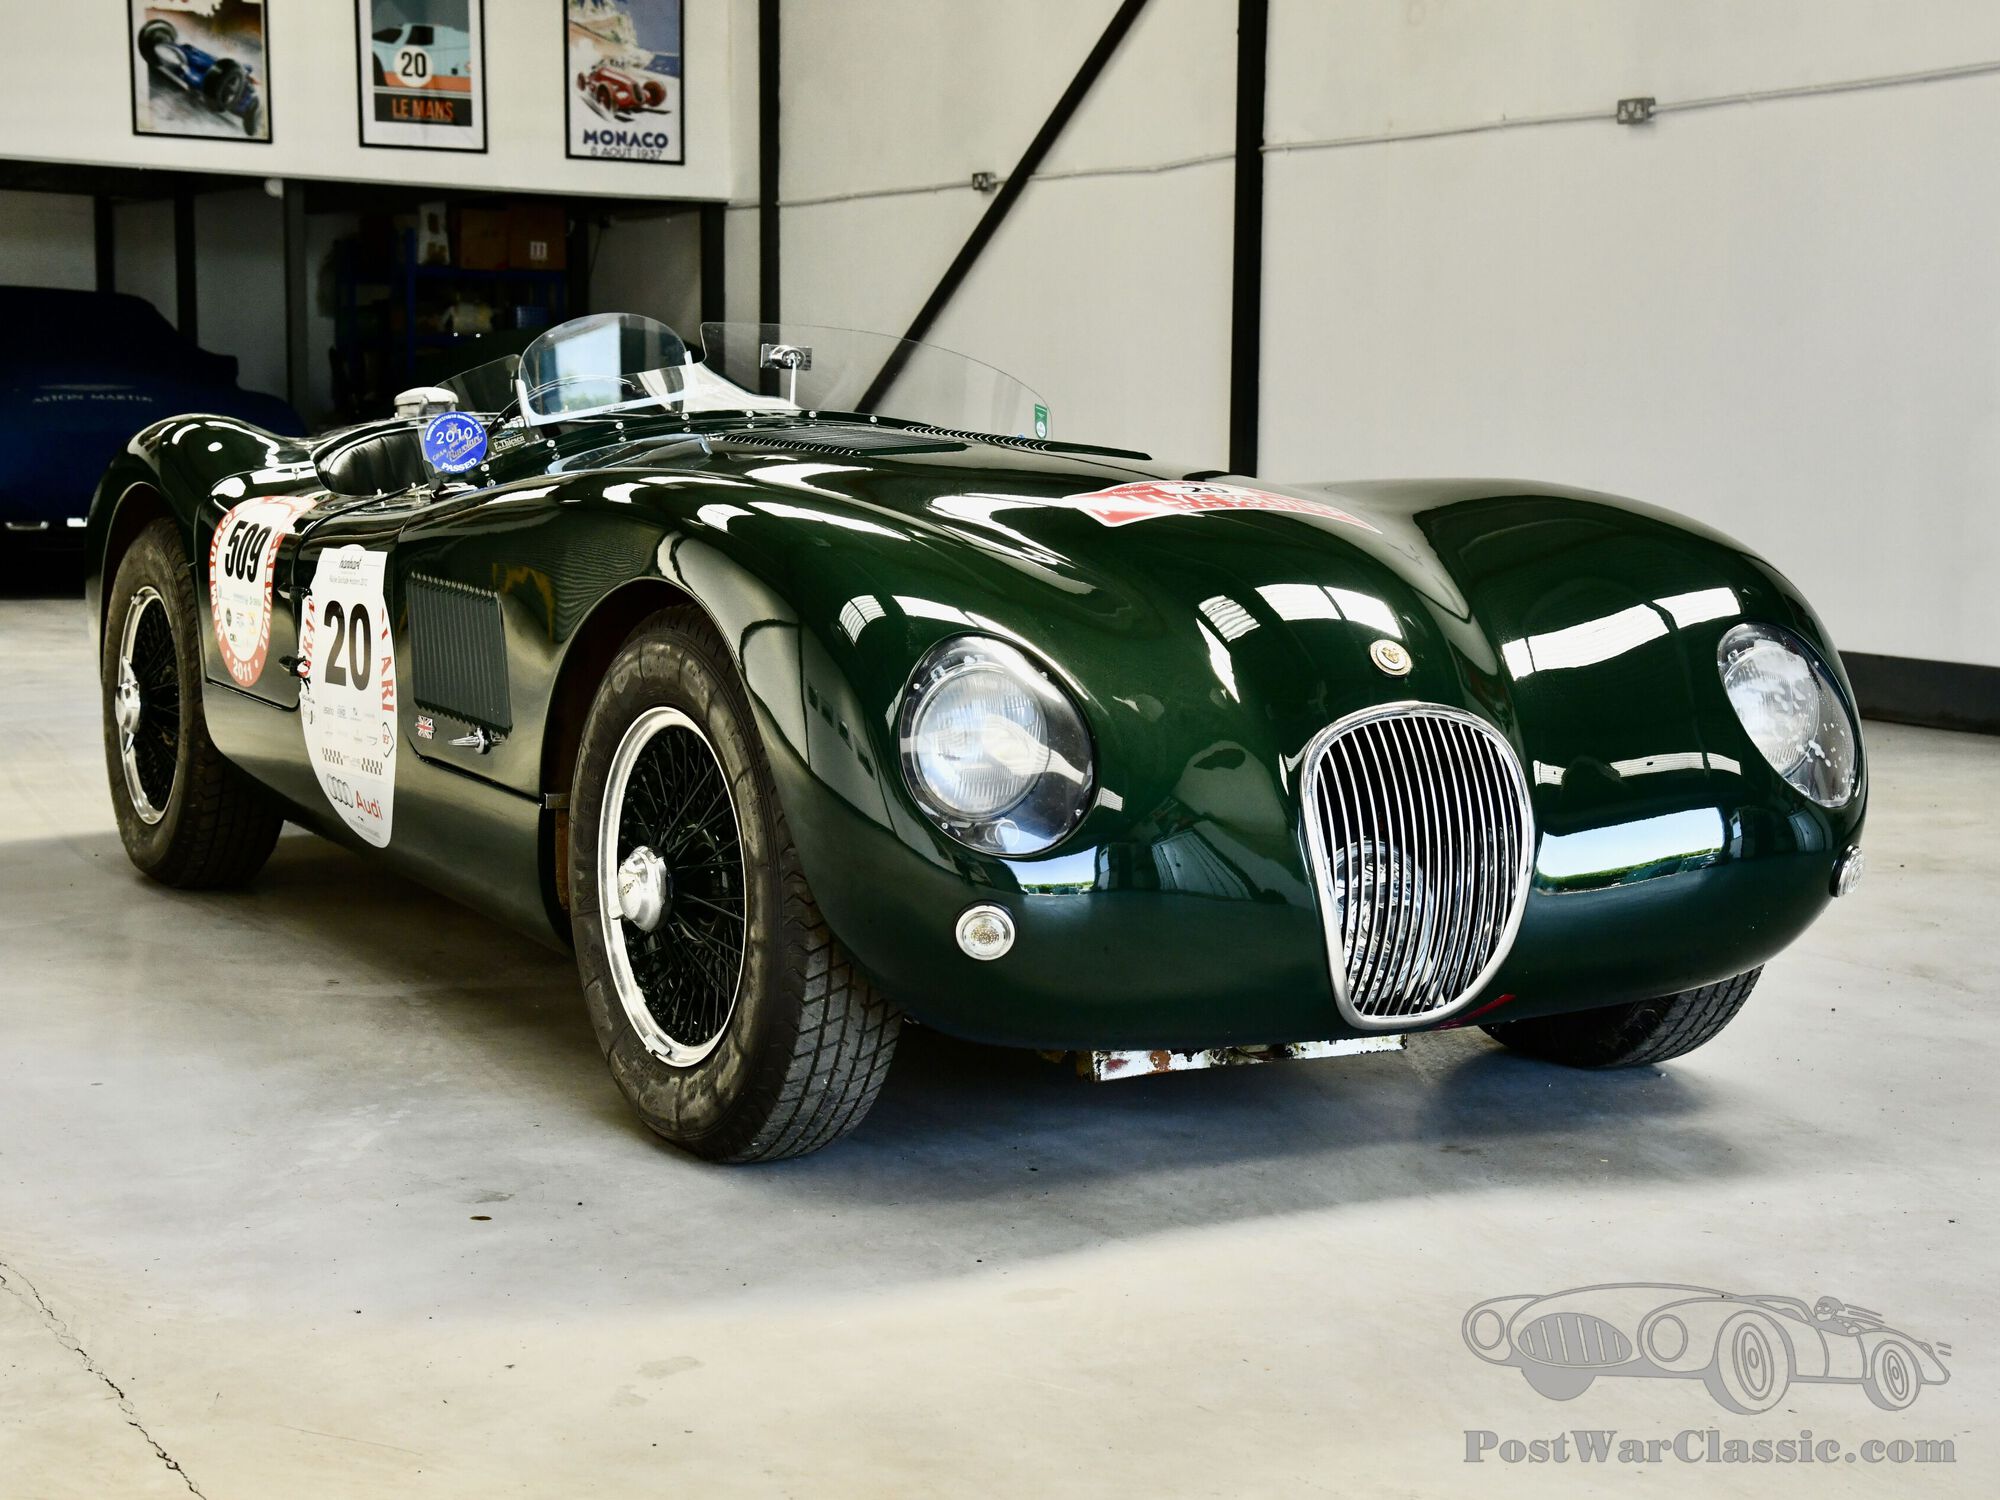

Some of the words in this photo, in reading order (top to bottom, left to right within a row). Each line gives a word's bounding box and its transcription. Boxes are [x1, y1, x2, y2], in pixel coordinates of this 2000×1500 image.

[401, 51, 427, 78] 20
[391, 97, 409, 119] LE
[412, 98, 454, 122] MANS
[583, 129, 668, 149] MONACO
[91, 394, 152, 402] MARTIN
[436, 426, 473, 445] 2010
[441, 458, 477, 473] PASSED
[225, 520, 272, 583] 509
[209, 511, 234, 640] HAMBURG
[323, 600, 371, 691] 20
[232, 660, 253, 681] 2011
[355, 790, 384, 821] Audi
